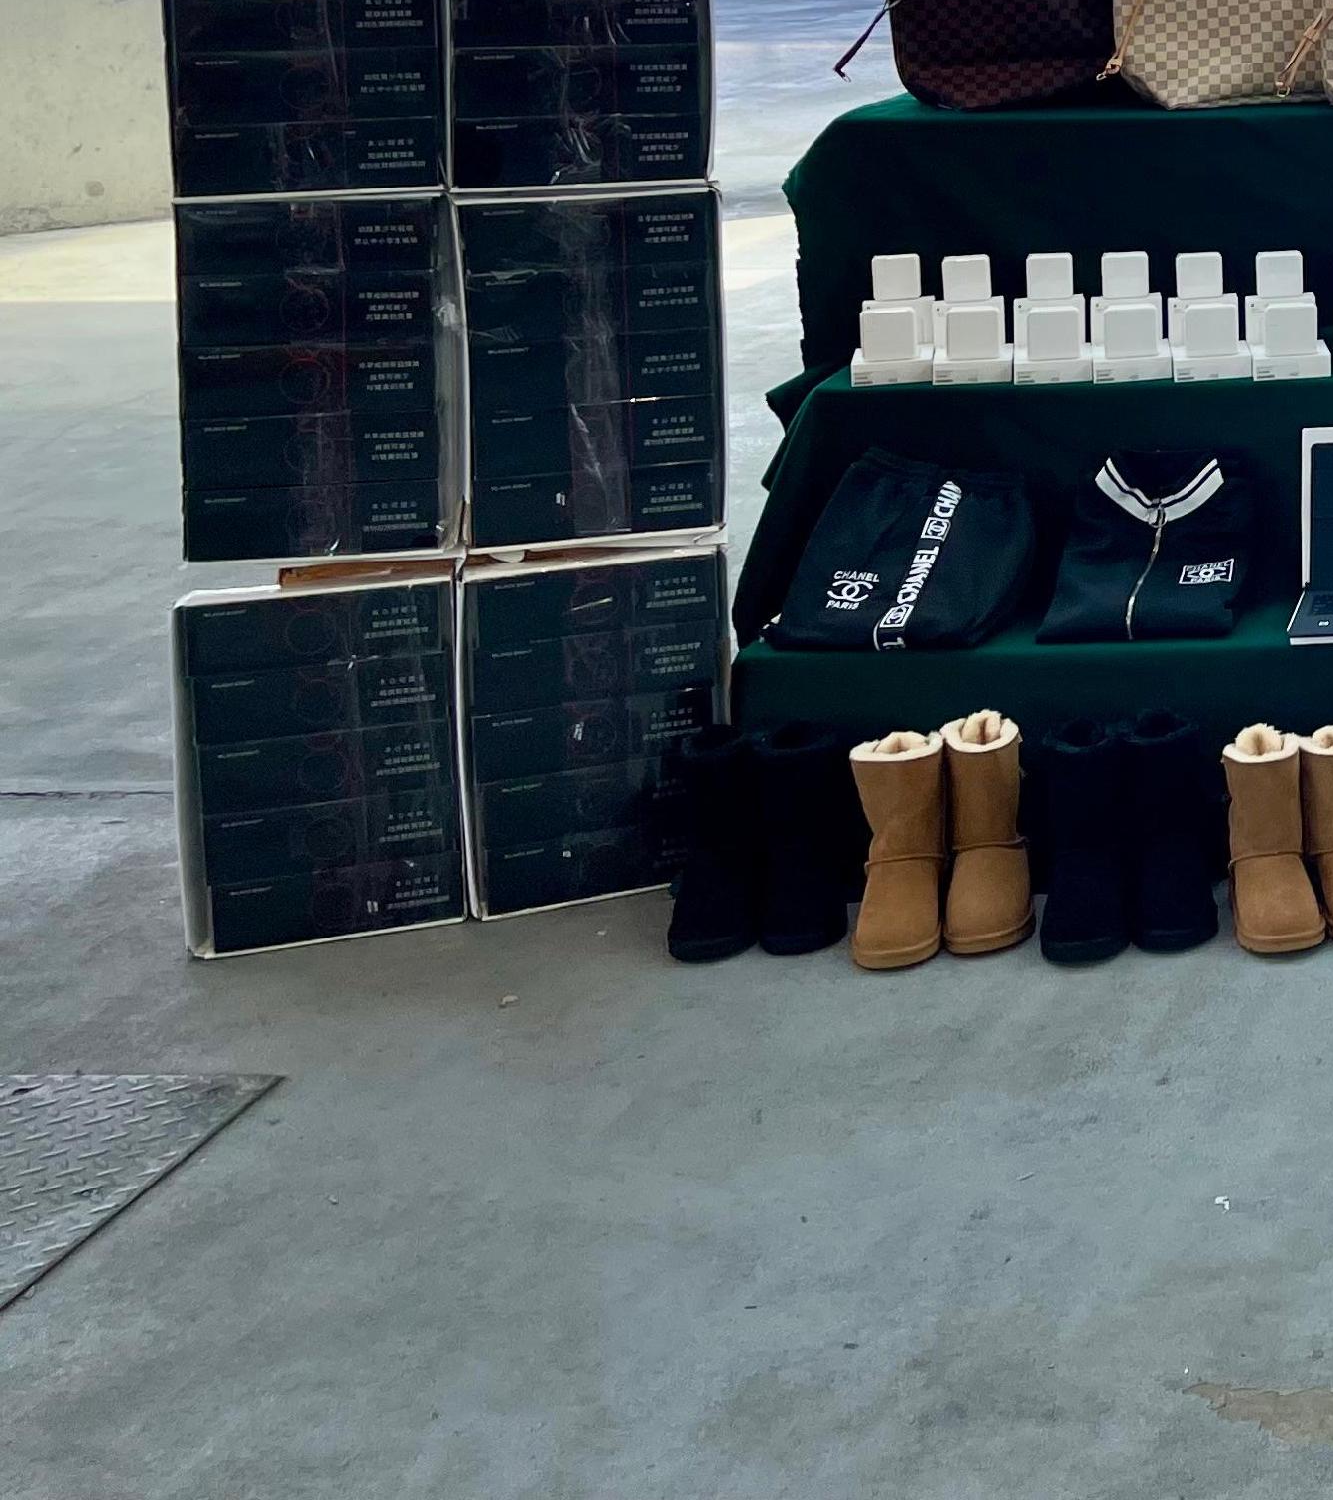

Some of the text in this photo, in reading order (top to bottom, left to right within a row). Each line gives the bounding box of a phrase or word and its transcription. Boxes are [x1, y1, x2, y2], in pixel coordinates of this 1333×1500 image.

[833, 570, 880, 583] CHANEL
[896, 545, 940, 605] CHANEL
[825, 599, 860, 610] PARIS
